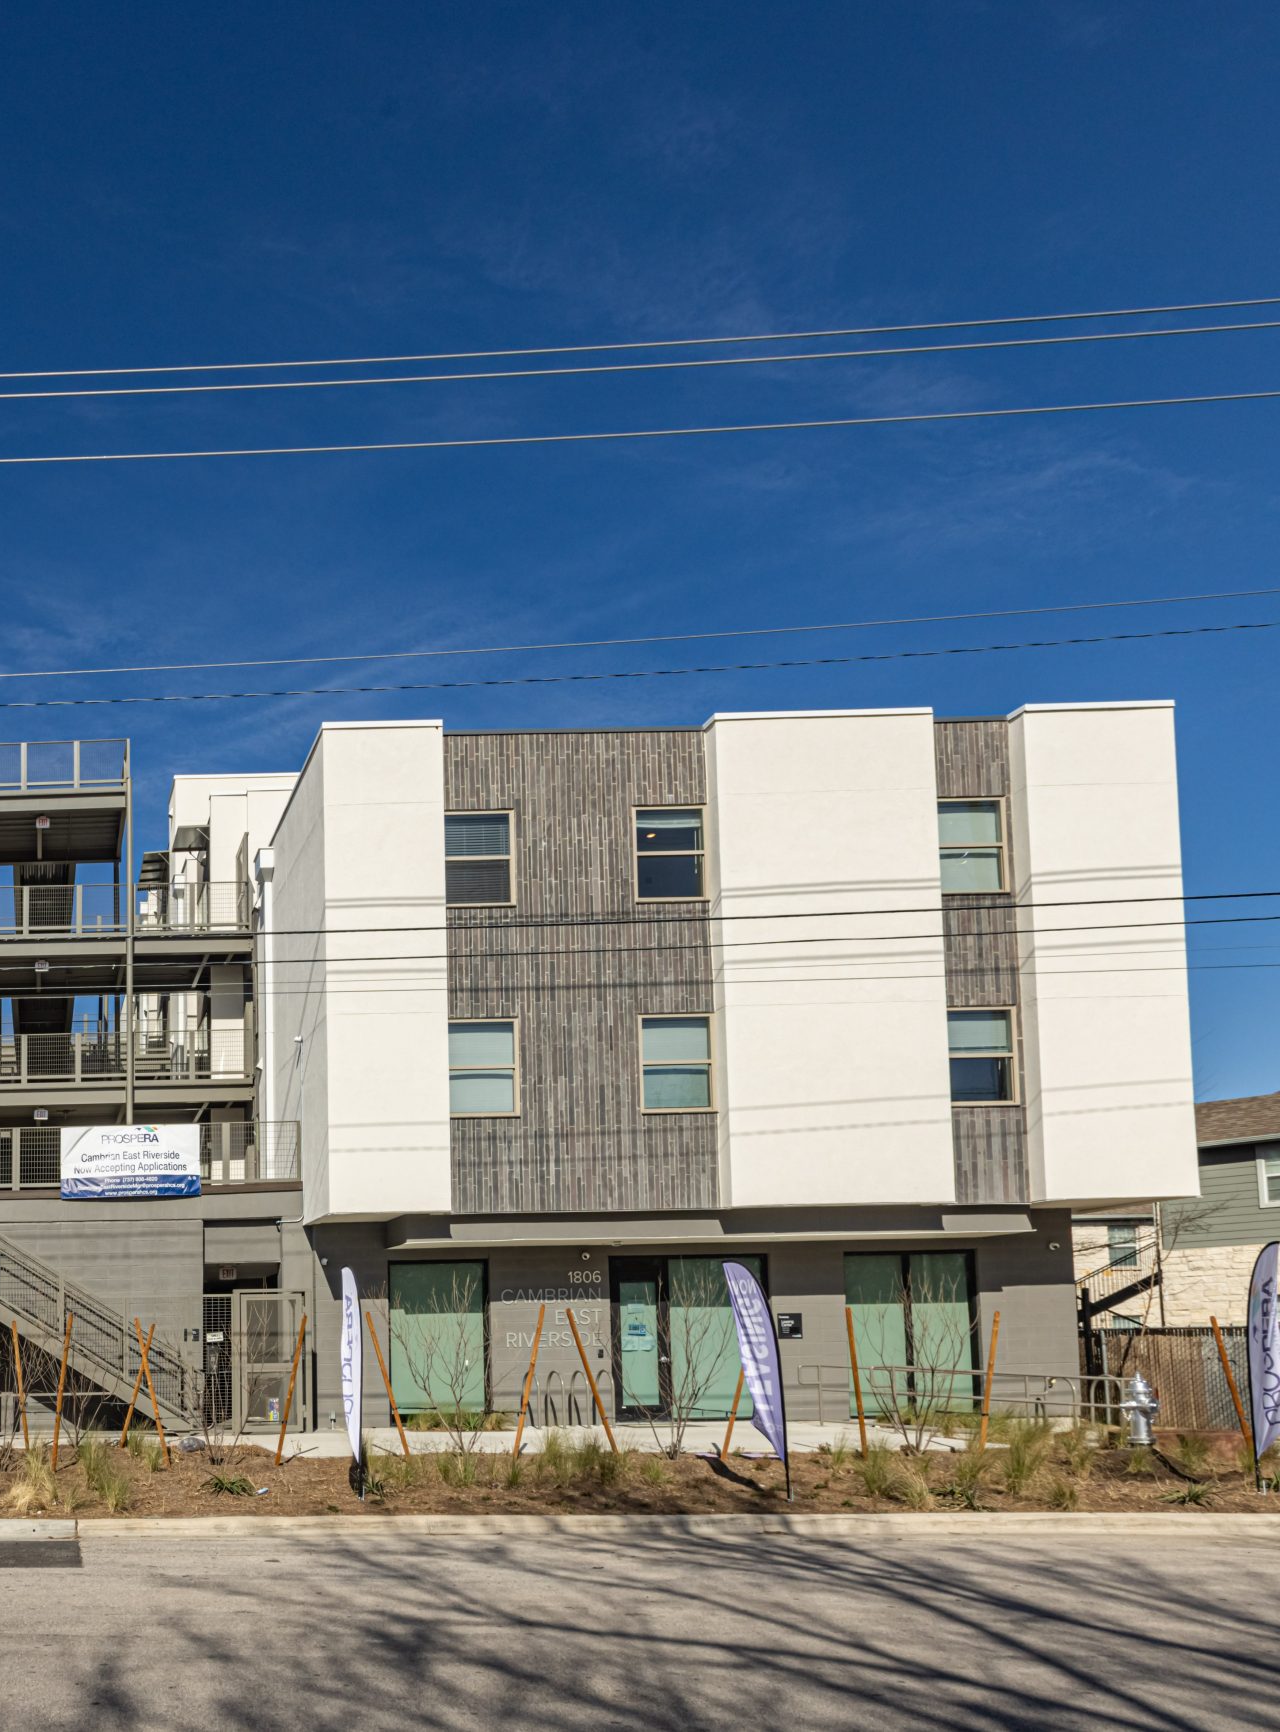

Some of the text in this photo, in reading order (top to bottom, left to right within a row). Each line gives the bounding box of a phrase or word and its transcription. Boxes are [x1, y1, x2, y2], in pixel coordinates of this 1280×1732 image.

[101, 1133, 160, 1145] PROSPERA
[81, 1149, 181, 1163] Cambrian East Riverside
[74, 1160, 188, 1175] Now Accepting Applications
[567, 1270, 602, 1284] 1806
[500, 1287, 602, 1305] CAMBRIAN
[555, 1308, 603, 1326] EAST
[506, 1331, 603, 1348] RIVERSIDE
